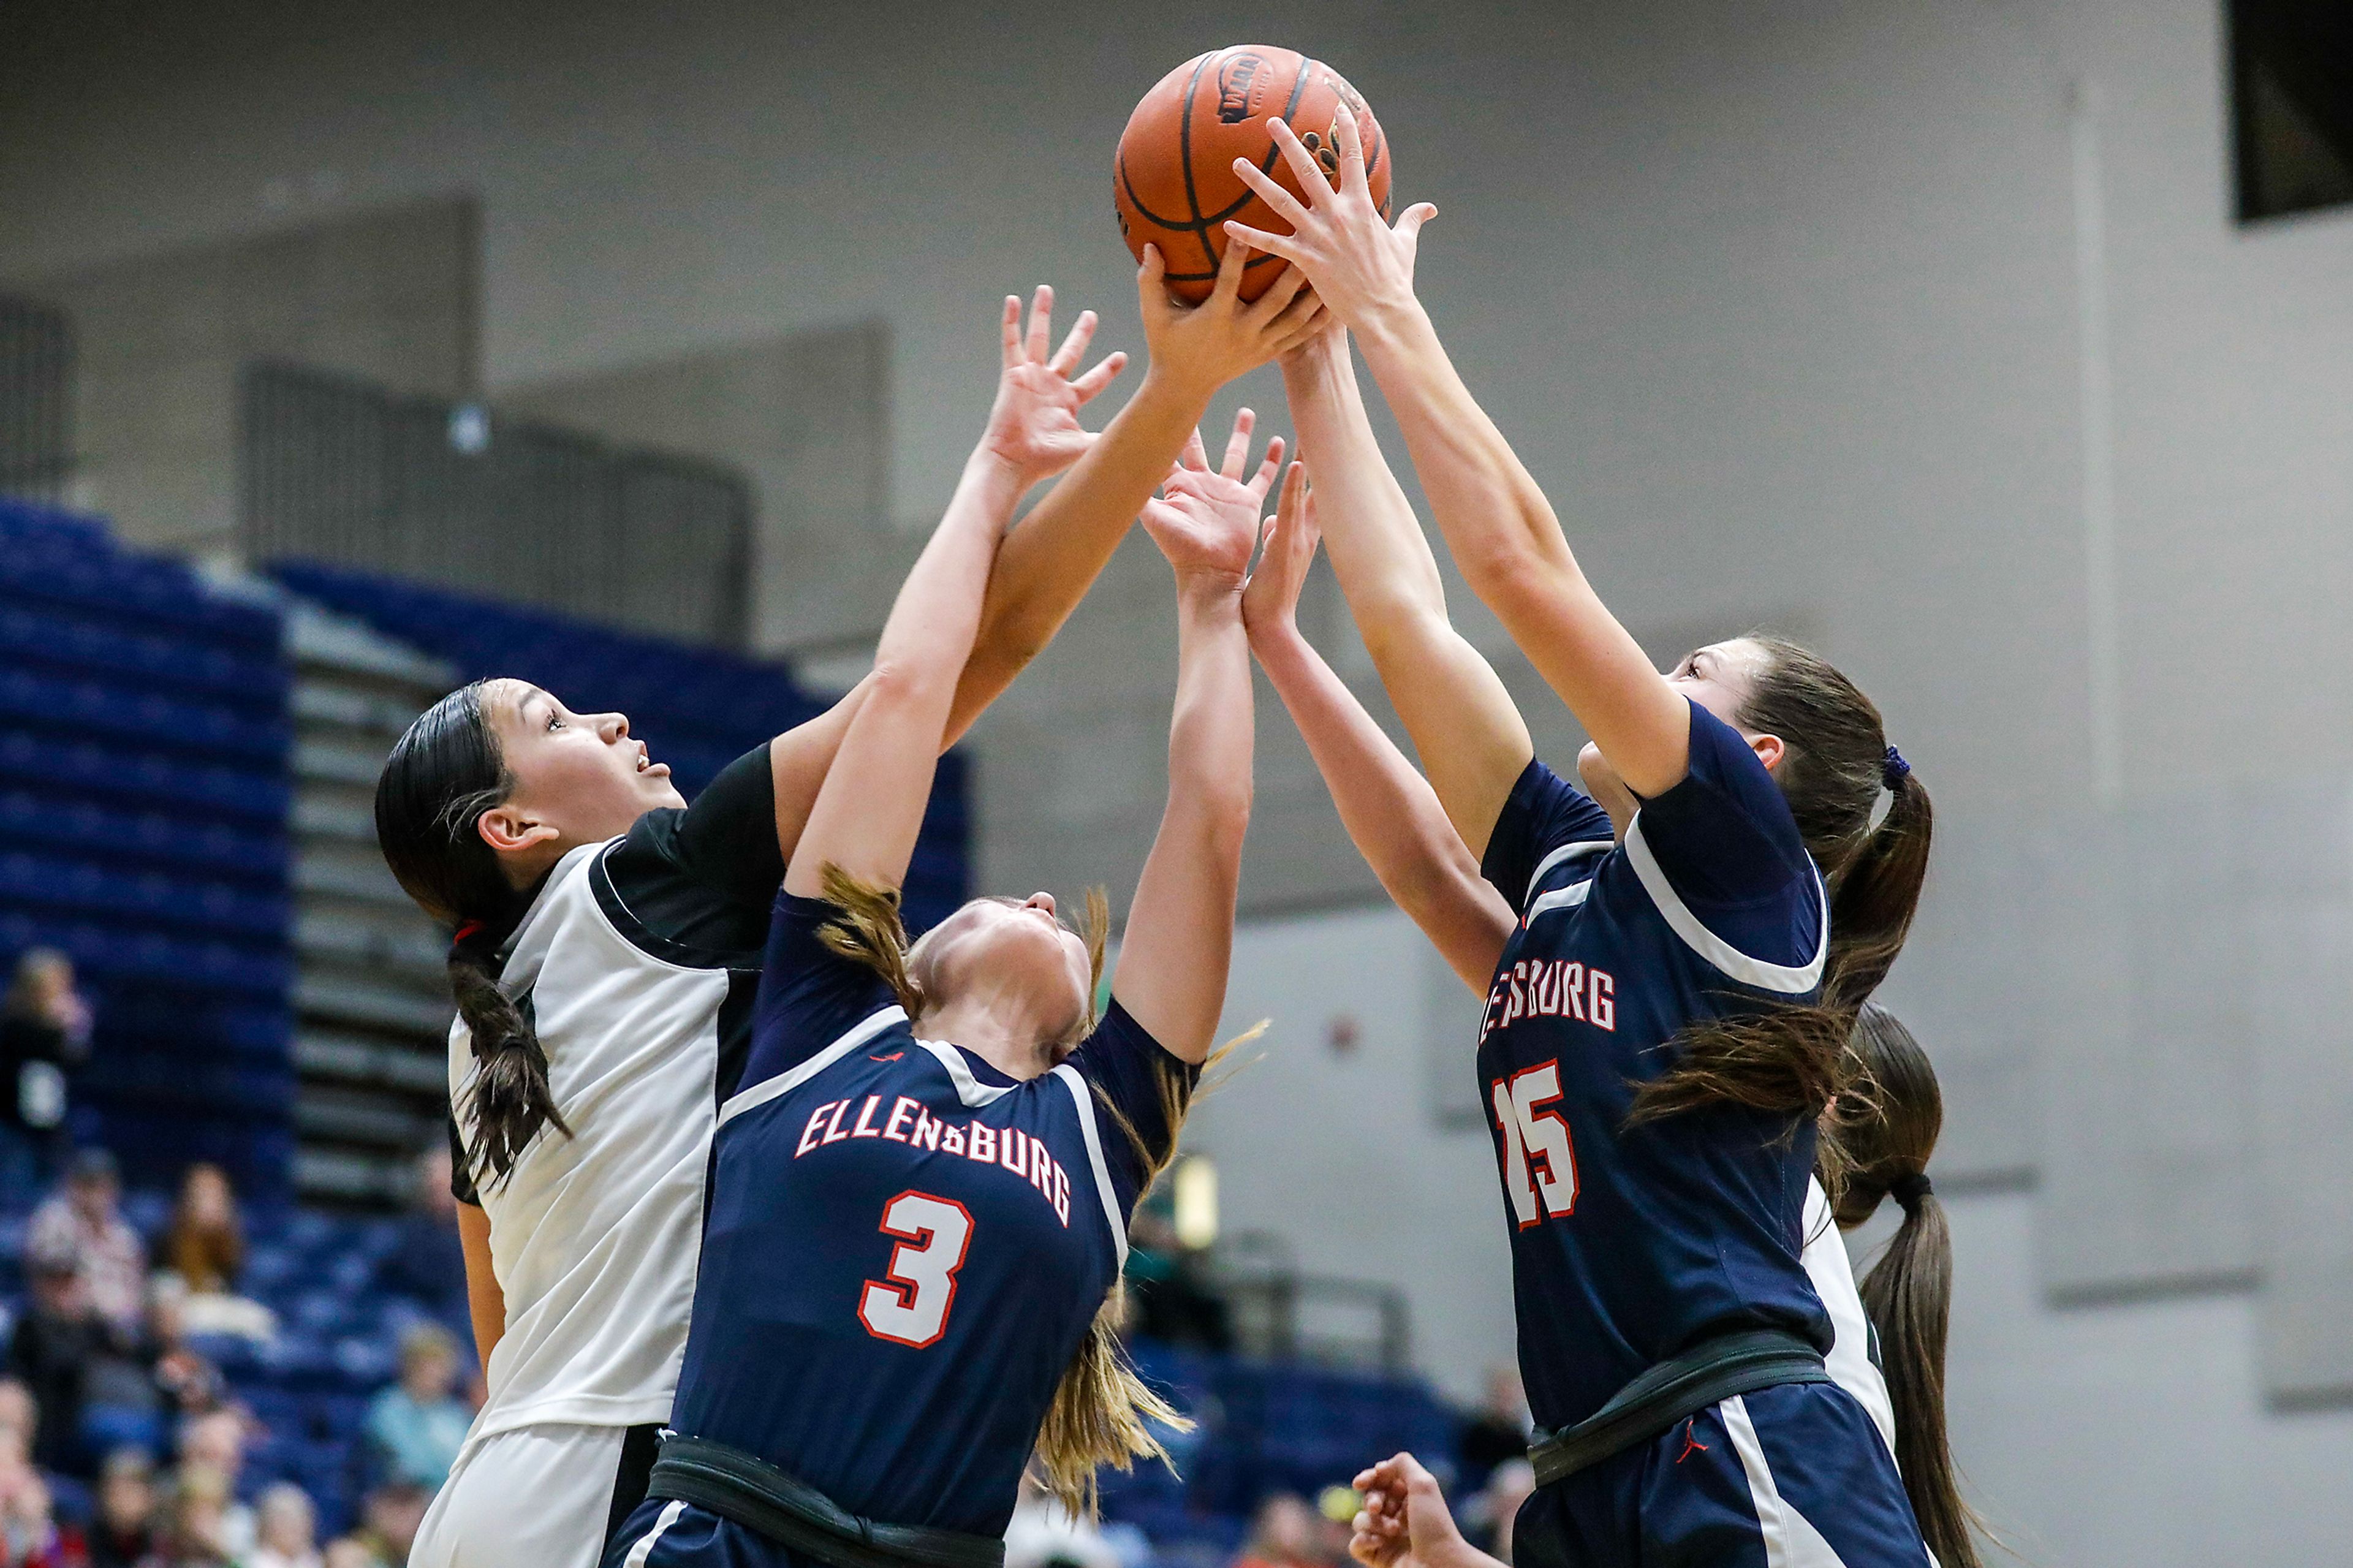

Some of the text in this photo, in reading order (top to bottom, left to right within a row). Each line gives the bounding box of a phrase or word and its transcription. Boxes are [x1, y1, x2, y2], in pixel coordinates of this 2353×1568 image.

[795, 1095, 1070, 1227] ELLENSBURG
[1491, 1058, 1580, 1232] 15
[857, 1189, 976, 1349] 3
